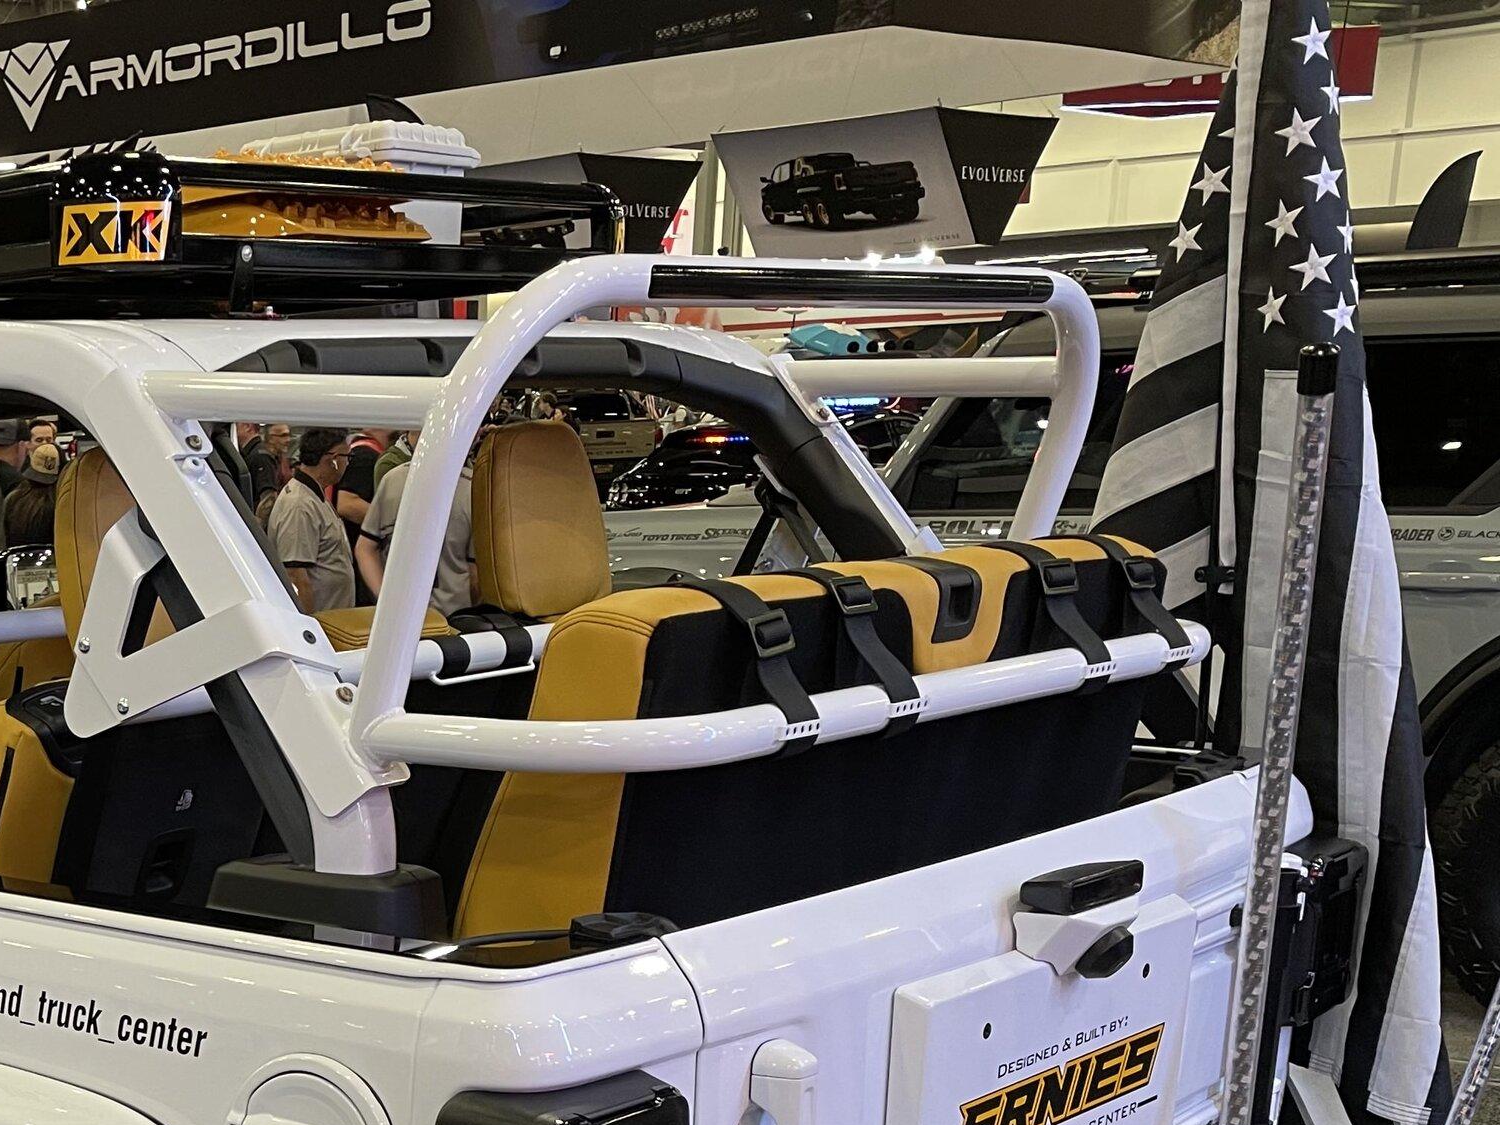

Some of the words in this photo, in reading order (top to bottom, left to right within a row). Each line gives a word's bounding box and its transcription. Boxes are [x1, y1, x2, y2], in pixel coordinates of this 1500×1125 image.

[56, 0, 431, 101] ARMORDILLO
[961, 165, 1026, 183] EVOLVERSE
[621, 203, 671, 219] OLVERSE
[642, 533, 669, 542] TOYO
[670, 533, 702, 541] TIRES
